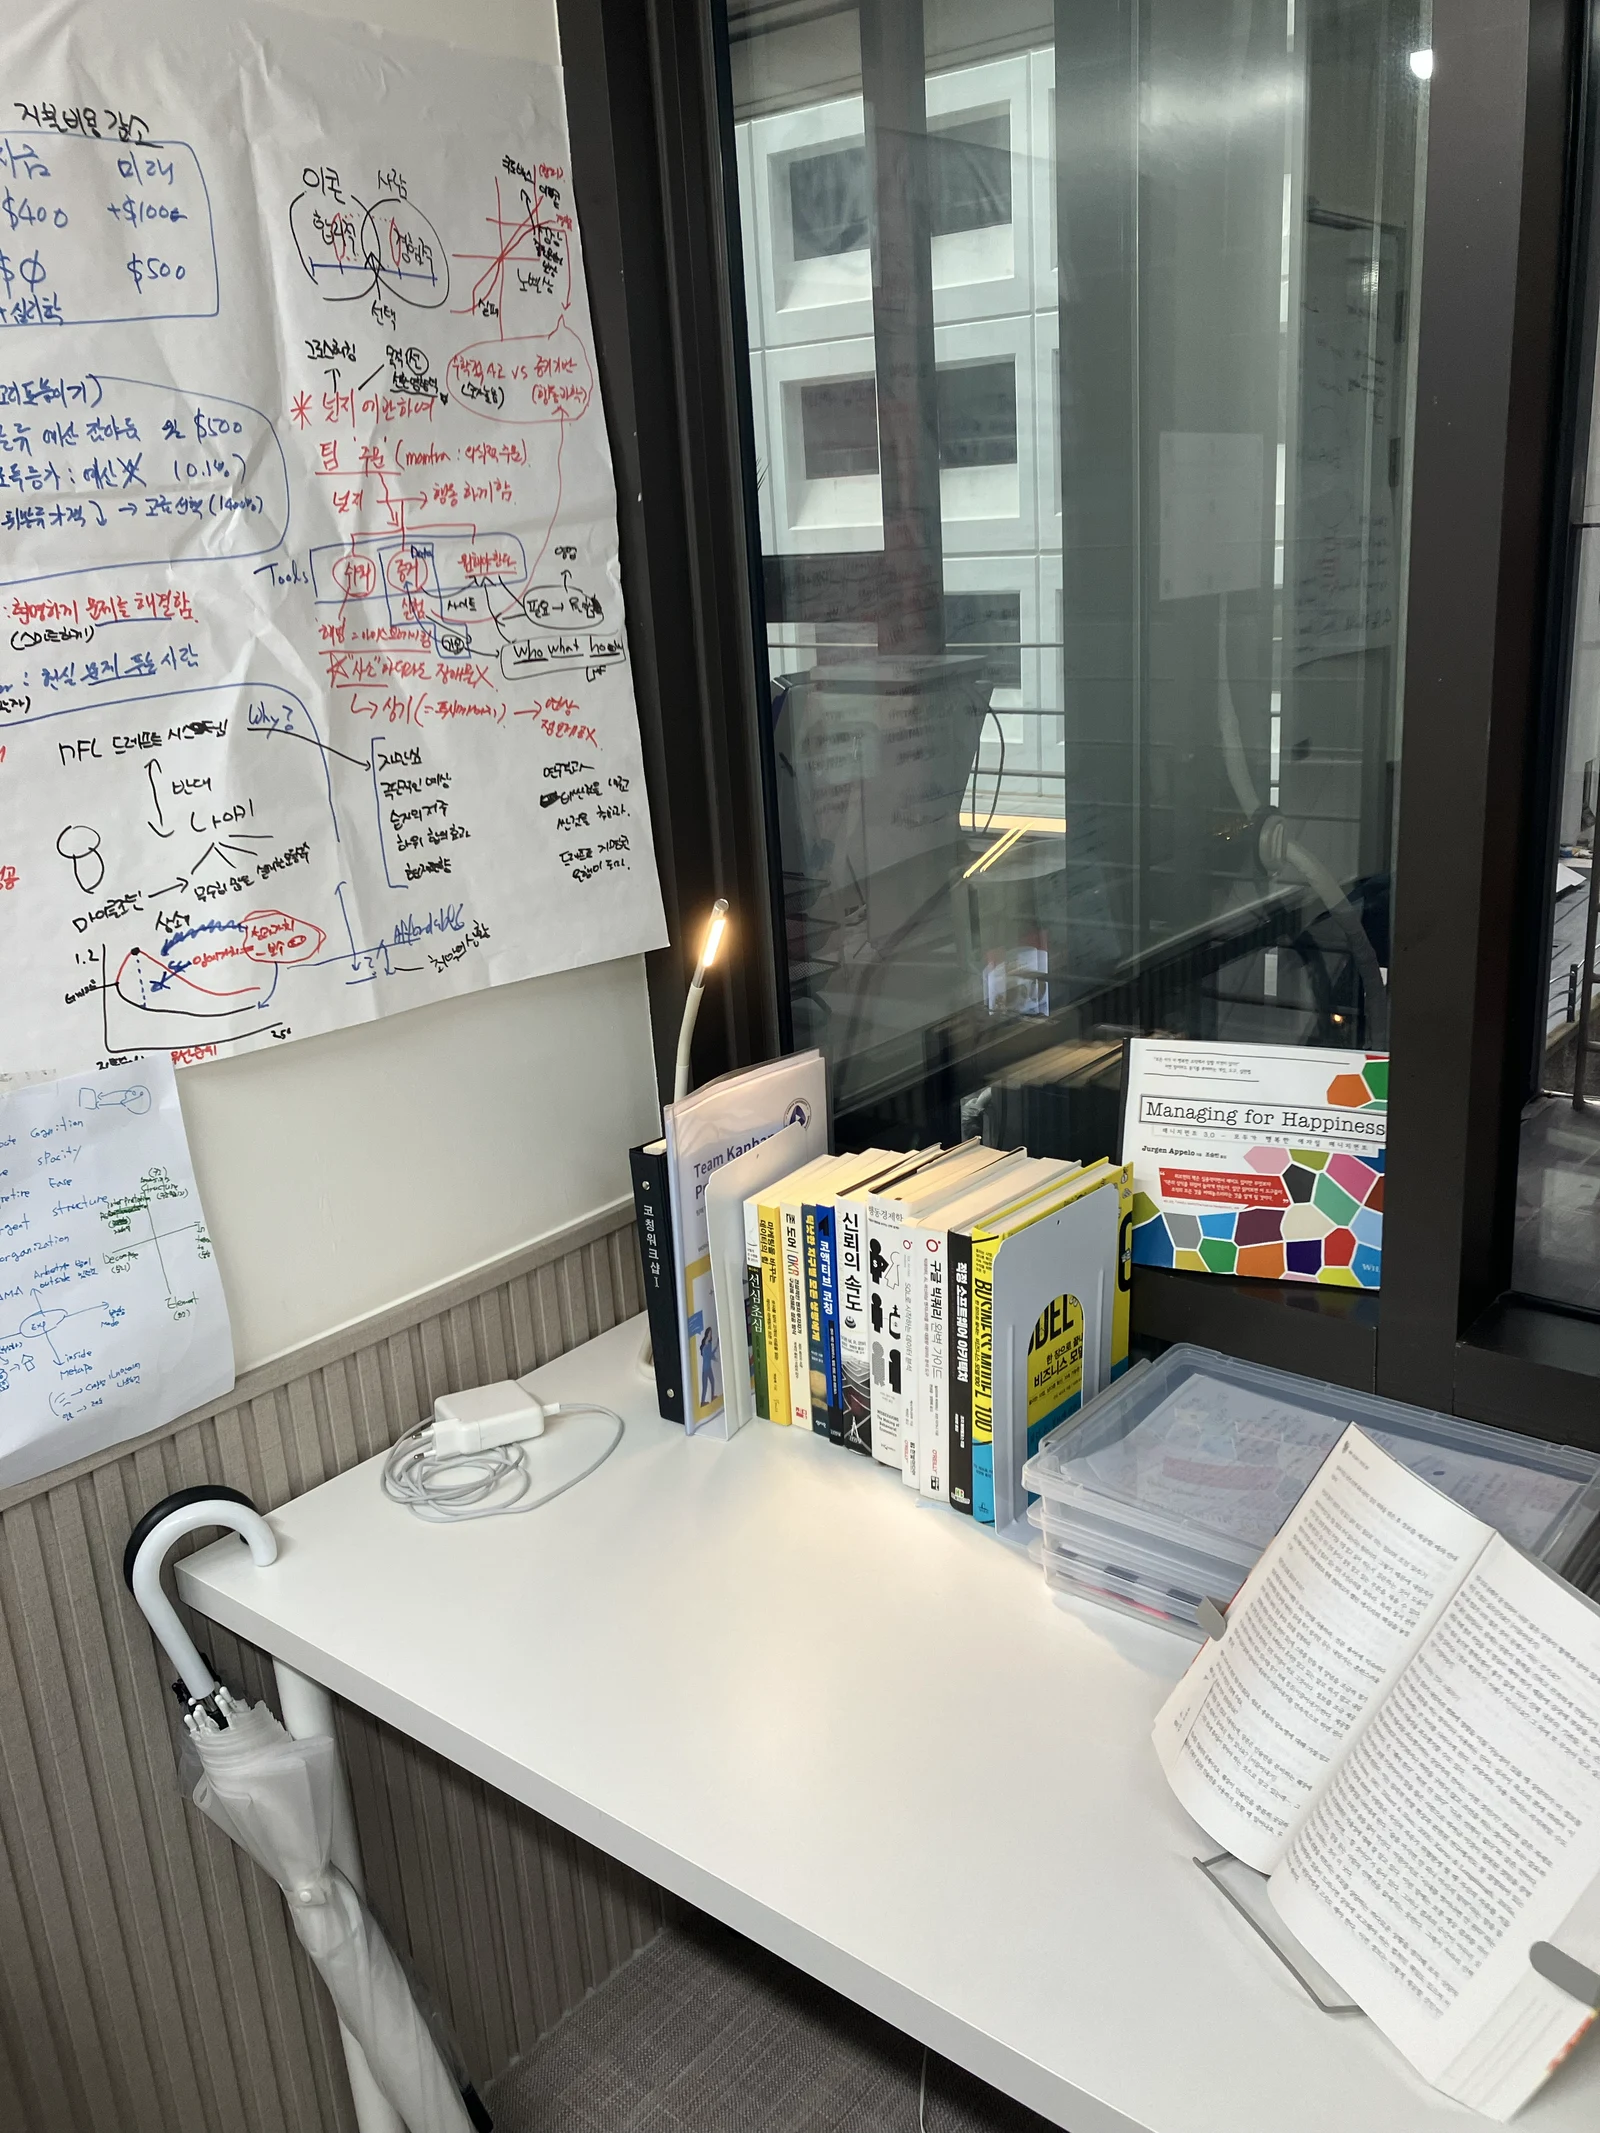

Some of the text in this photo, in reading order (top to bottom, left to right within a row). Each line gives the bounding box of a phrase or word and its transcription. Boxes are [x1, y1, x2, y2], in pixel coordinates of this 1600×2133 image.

[126, 252, 187, 294] $500
[1145, 1101, 1386, 1137] Managing for Happiness
[1141, 1145, 1168, 1155] Jurgen
[1168, 1148, 1196, 1158] Appelo
[1203, 1131, 1216, 1139] 3.0
[1233, 1133, 1258, 1142] 모두가
[1265, 1136, 1290, 1145] 행복한
[693, 1152, 725, 1178] Team
[759, 1219, 768, 1253] 데이터의
[785, 1213, 797, 1248] 존 도어
[769, 1257, 778, 1284] 바꾸는
[786, 1253, 800, 1276] OKR
[820, 1240, 832, 1288] 코액티브
[842, 1212, 863, 1312] 신뢰의 속도
[930, 1260, 942, 1284] 구글
[809, 1279, 818, 1299] 모든
[823, 1290, 834, 1315] 코칭
[930, 1287, 943, 1321] 빅쿼리
[810, 1302, 820, 1341] 생명에게
[930, 1322, 943, 1345] 완벽
[956, 1262, 968, 1382] 적정 소프트웨어 아키텍처
[931, 1347, 943, 1379] 가이드
[1054, 1343, 1073, 1361] 장으로
[1034, 1356, 1069, 1388] 비즈니스
[974, 1404, 993, 1433] 100
